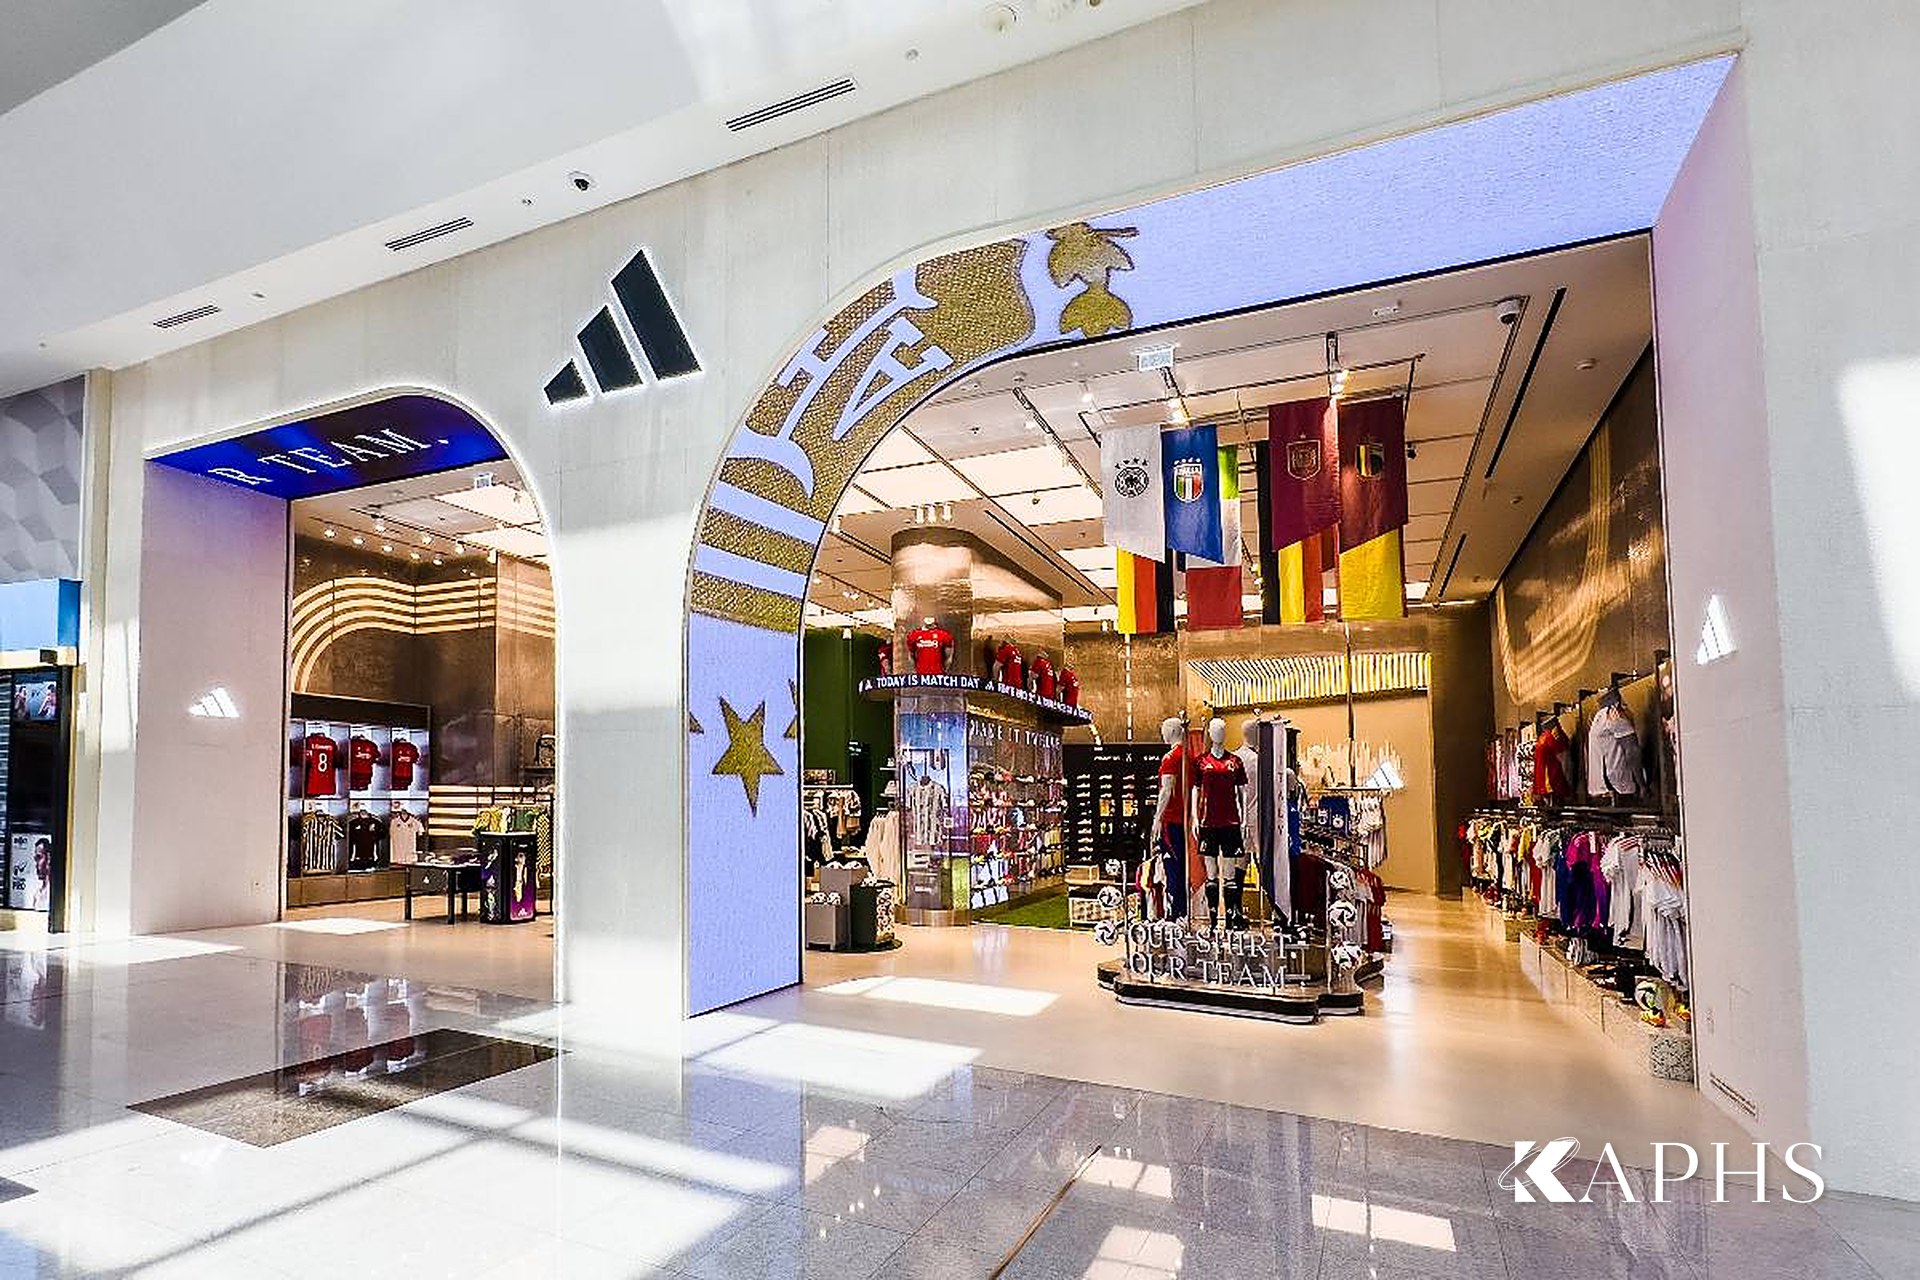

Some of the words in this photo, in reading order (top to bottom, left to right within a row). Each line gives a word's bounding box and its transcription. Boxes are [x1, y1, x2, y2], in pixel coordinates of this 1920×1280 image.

[876, 675, 906, 688] TODAY
[908, 674, 918, 686] IS
[920, 674, 958, 687] MATCH
[960, 676, 981, 689] DAY
[317, 752, 328, 773] 8
[1129, 921, 1187, 950] OUR
[1129, 950, 1188, 982] OUR
